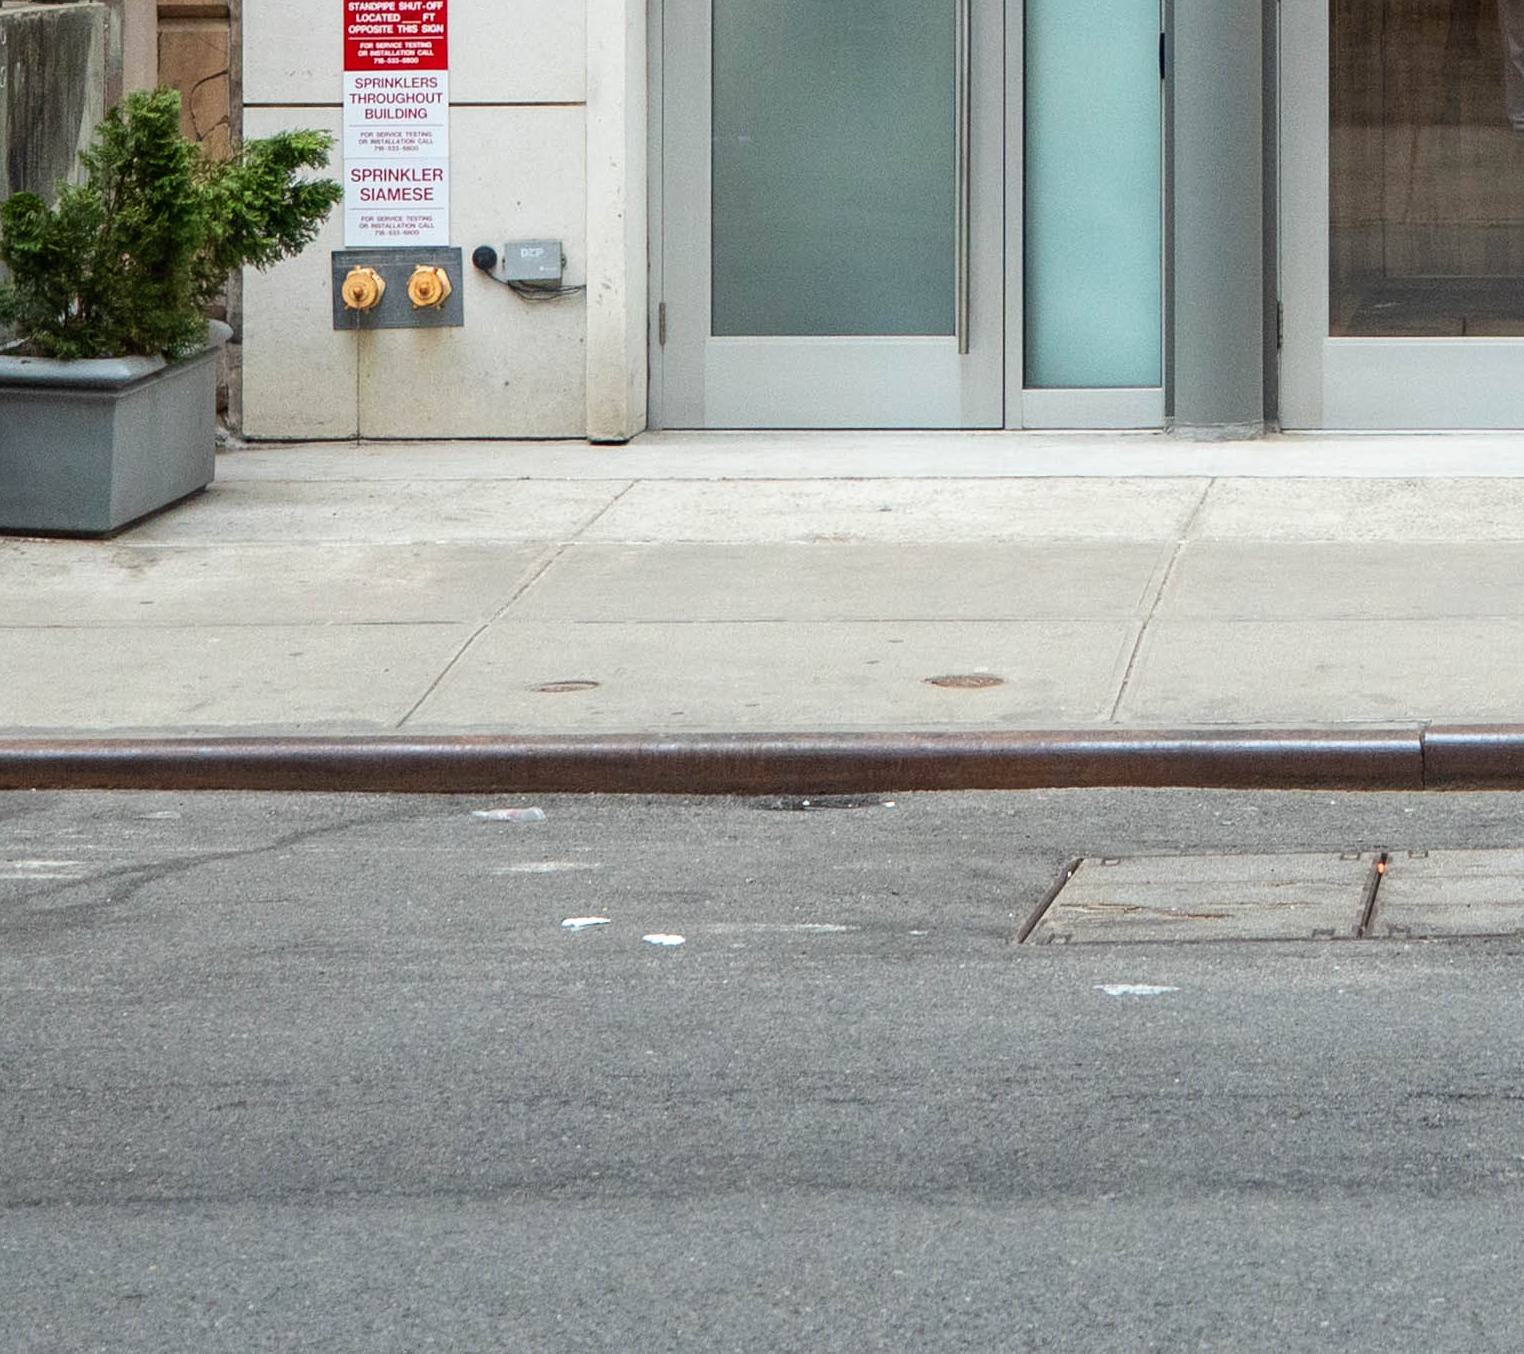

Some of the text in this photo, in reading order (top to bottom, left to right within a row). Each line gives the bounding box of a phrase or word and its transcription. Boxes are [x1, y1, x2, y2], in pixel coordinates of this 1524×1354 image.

[348, 1, 443, 11] STANDPIPE SHUT-OFF
[356, 13, 435, 22] LOCATED FT
[348, 24, 444, 34] OPPOSITE THIS SIGN
[370, 49, 415, 57] INSTALLATION
[354, 77, 438, 89] SPRINKLERS
[349, 92, 443, 104] THROUGHOUT
[364, 108, 428, 119] BUILDING
[351, 168, 443, 182] SPRINKLER
[360, 187, 434, 201] SIAMESE
